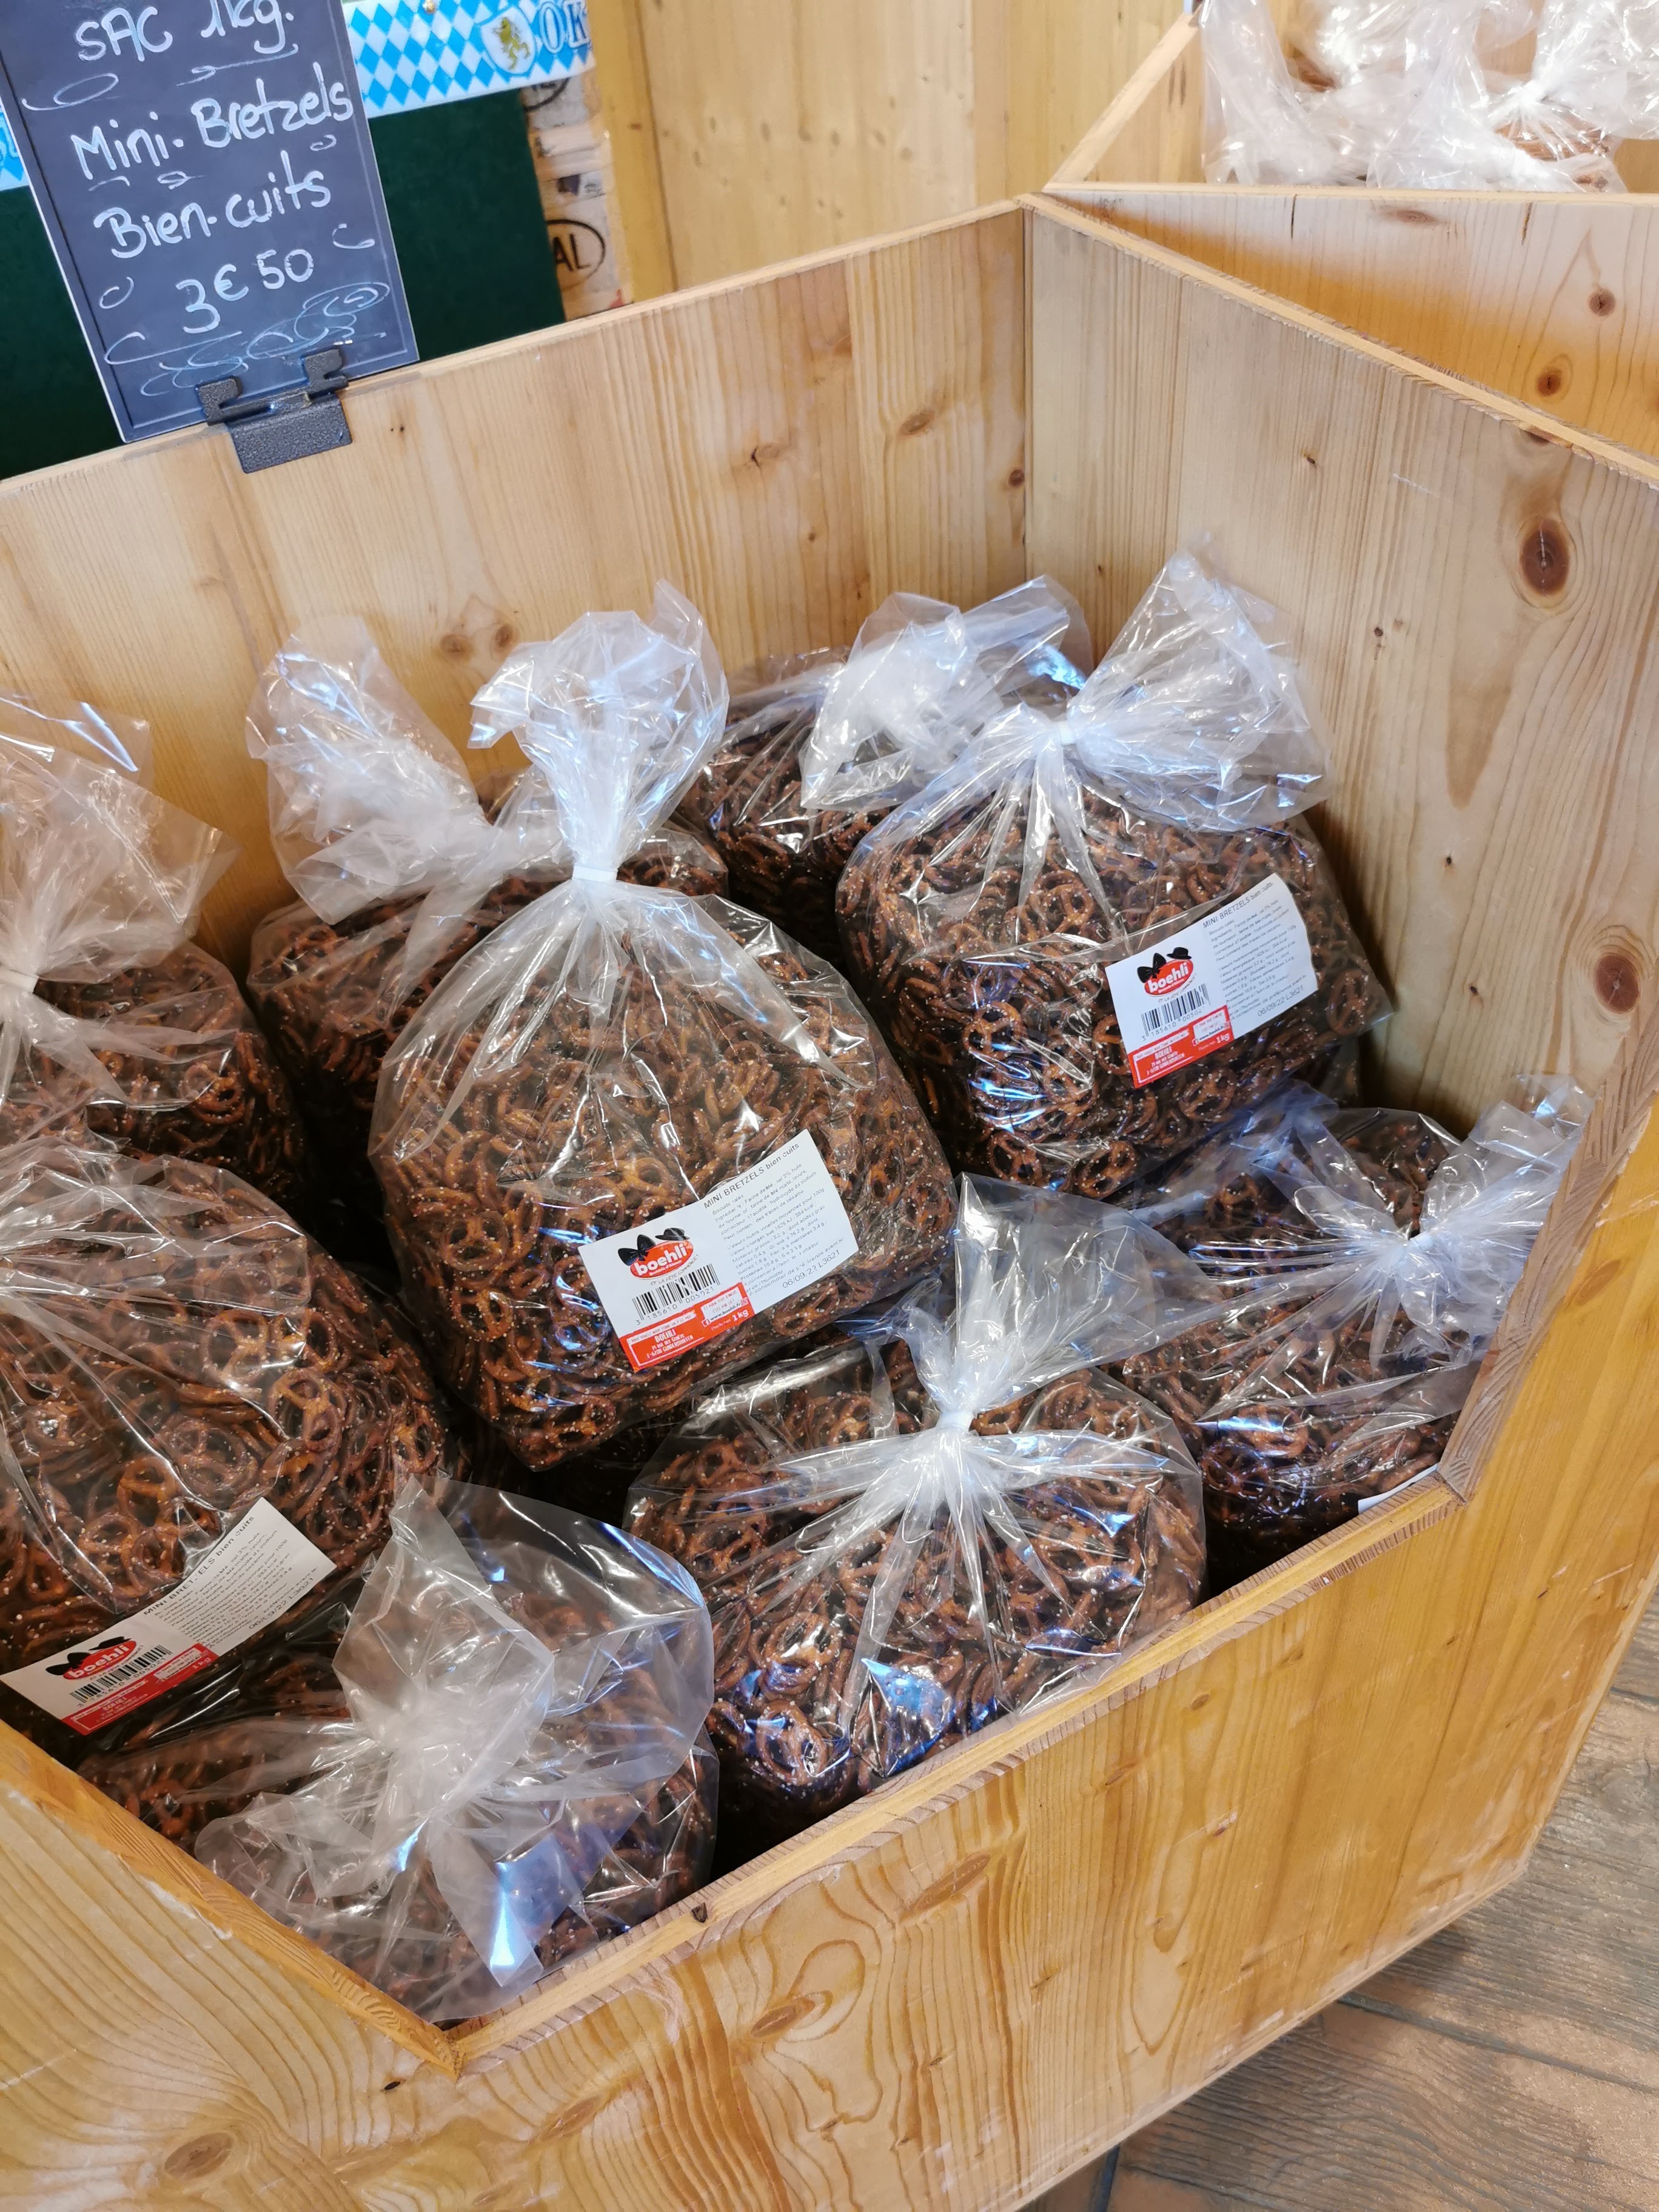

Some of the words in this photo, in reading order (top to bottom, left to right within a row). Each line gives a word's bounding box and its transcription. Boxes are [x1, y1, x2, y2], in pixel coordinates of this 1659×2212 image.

[75, 7, 173, 61] SAC
[191, 62, 354, 148] Bretzels
[1202, 916, 1218, 928] MINI
[1219, 896, 1250, 919] BRETZELS
[1249, 890, 1261, 900] bien
[1148, 963, 1189, 991] boehli
[1151, 1021, 1176, 1036] 185610
[1181, 1006, 1204, 1022] 00502
[1219, 1033, 1230, 1041] kg
[703, 1193, 722, 1208] MINI
[723, 1167, 764, 1196] BRETZELS
[765, 1156, 781, 1169] bien
[782, 1143, 799, 1157] cuits
[769, 1187, 794, 1204] hydroxyde
[800, 1171, 816, 1184] sodium
[725, 1208, 748, 1223] tourneol
[736, 1221, 754, 1234] contenr
[764, 1205, 779, 1216] traces
[745, 1218, 778, 1239] nutritonnelles
[778, 1202, 802, 1220] moyennes
[802, 1195, 812, 1205] pour
[812, 1187, 825, 1197] 100g
[788, 1221, 799, 1230] dont
[799, 1212, 814, 1224] acides
[814, 1205, 825, 1215] gras
[746, 1229, 774, 1247] énergétque
[768, 1235, 790, 1250] Glcids
[807, 1217, 819, 1227] dont
[769, 1246, 785, 1257] Fibrs
[785, 1229, 813, 1248] amentaires
[635, 1243, 688, 1276] boehli
[754, 1273, 786, 1293] consommer
[795, 1251, 823, 1270] préfrence
[825, 1241, 838, 1252] avant
[817, 1249, 839, 1268] L3621
[646, 1303, 677, 1319] 185610
[709, 1302, 740, 1321] www.boehli.fr
[737, 1309, 749, 1318] kg
[654, 1329, 676, 1342] BOEHLI
[143, 1596, 167, 1615] MINI
[168, 1557, 215, 1599] BRETELS
[215, 1538, 234, 1556] bien
[235, 1516, 254, 1536] cuits
[68, 1643, 129, 1678] boehli
[198, 1657, 211, 1666] kg
